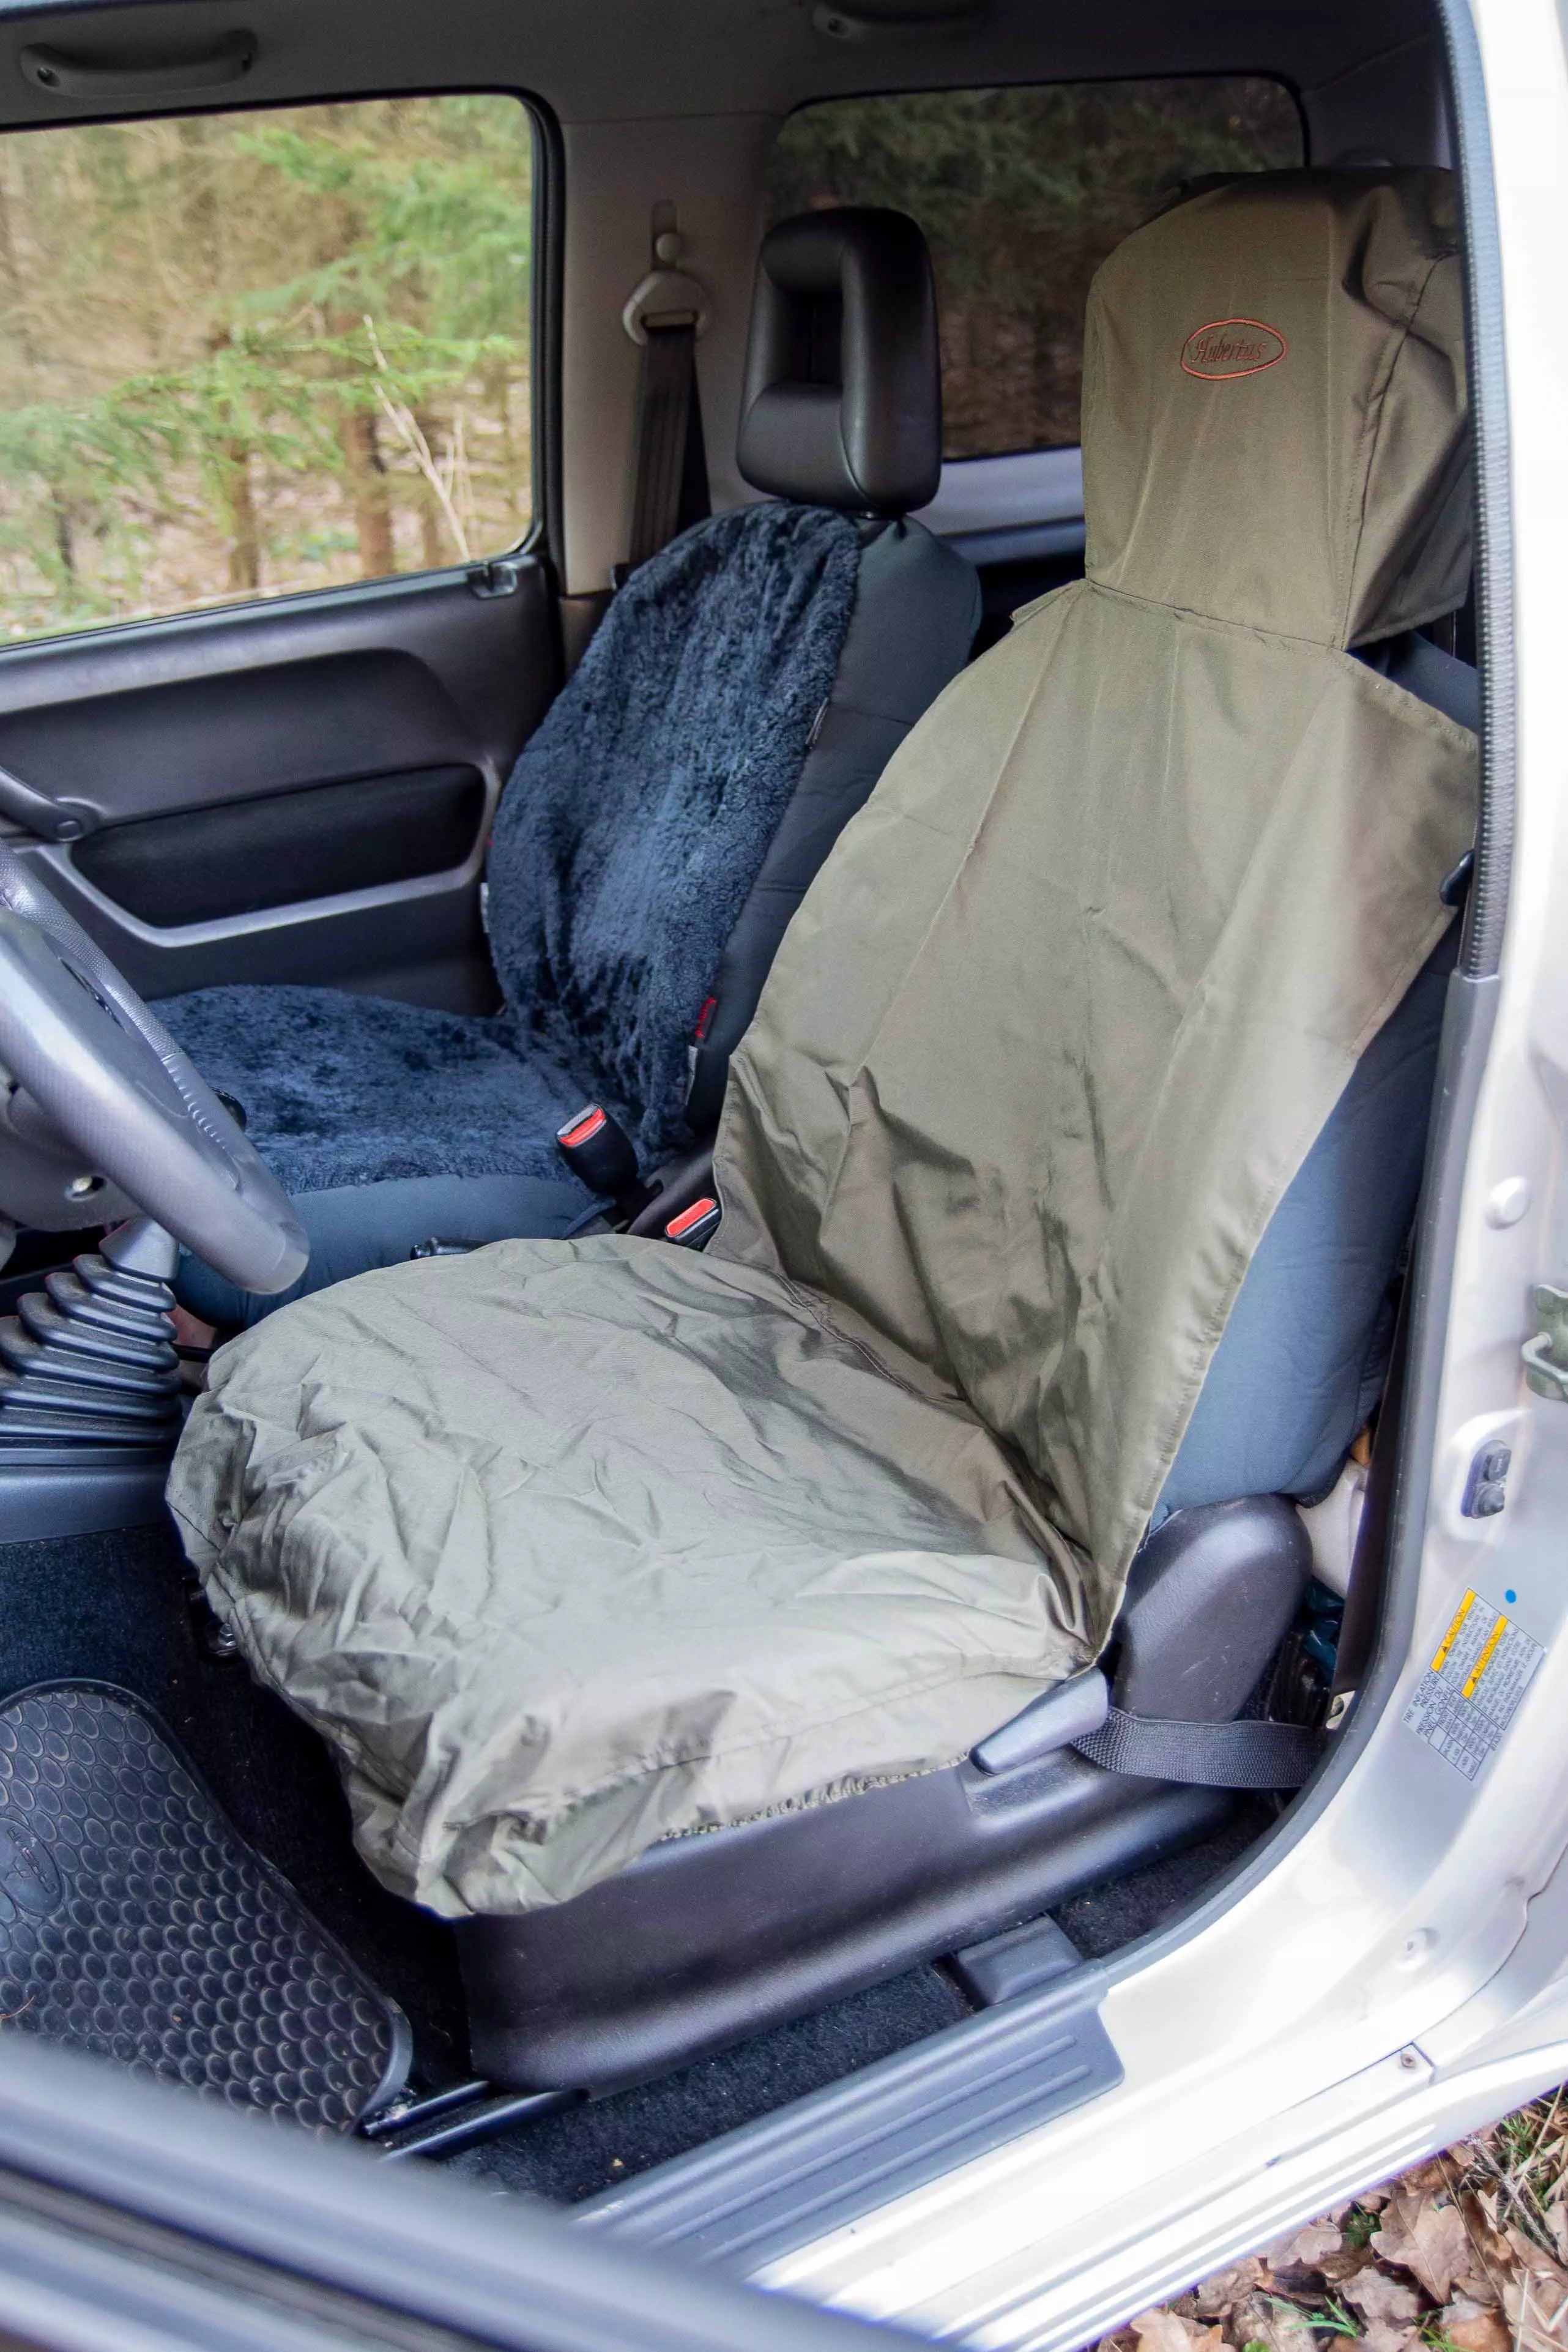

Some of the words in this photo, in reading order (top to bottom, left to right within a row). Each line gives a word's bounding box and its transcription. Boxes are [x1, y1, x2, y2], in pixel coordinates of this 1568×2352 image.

[1191, 330, 1267, 363] Hubertus
[1444, 1608, 1466, 1643] CAUTION
[1473, 1631, 1499, 1676] ATTENTION
[1403, 1708, 1414, 1723] TIRE
[1412, 1669, 1434, 1707] INFLATION
